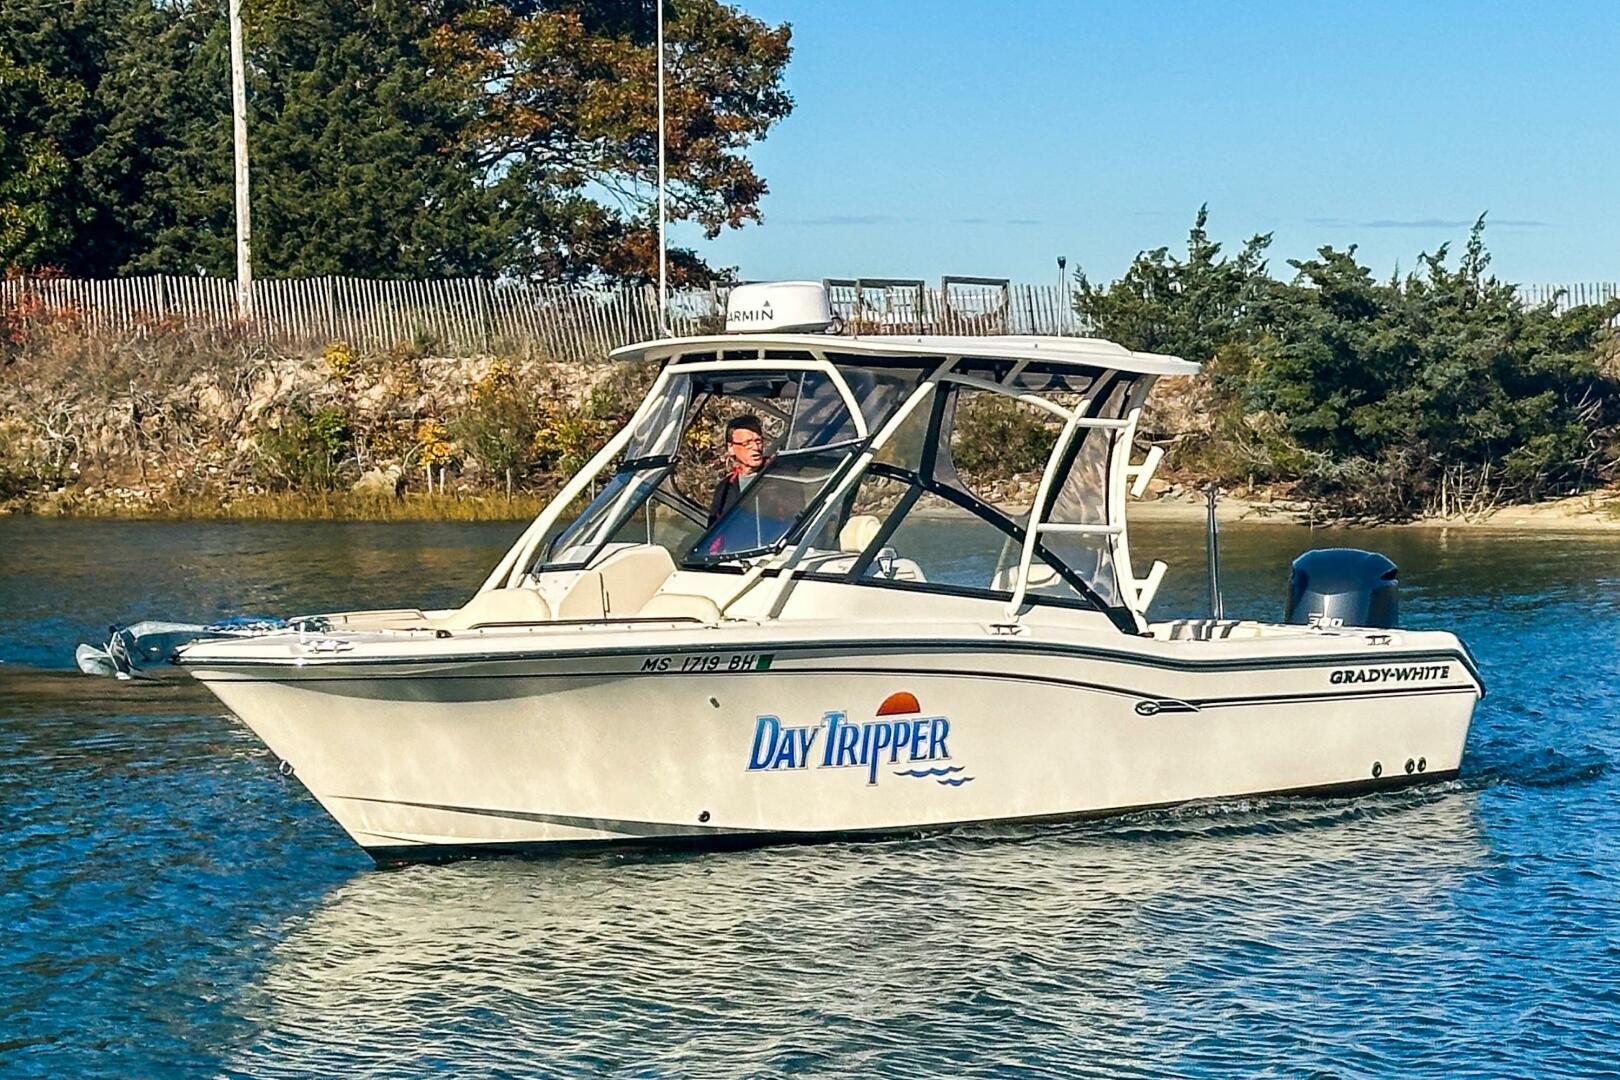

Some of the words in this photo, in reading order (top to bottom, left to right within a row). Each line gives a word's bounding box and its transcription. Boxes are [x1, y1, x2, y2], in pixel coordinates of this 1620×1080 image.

[727, 309, 773, 322] ARMIN
[641, 657, 672, 671] MS
[682, 655, 720, 671] 1719
[728, 654, 755, 670] BH
[1330, 665, 1450, 684] GRADY-WHITE
[746, 715, 821, 771] DAY
[817, 711, 952, 786] TRIPPER
